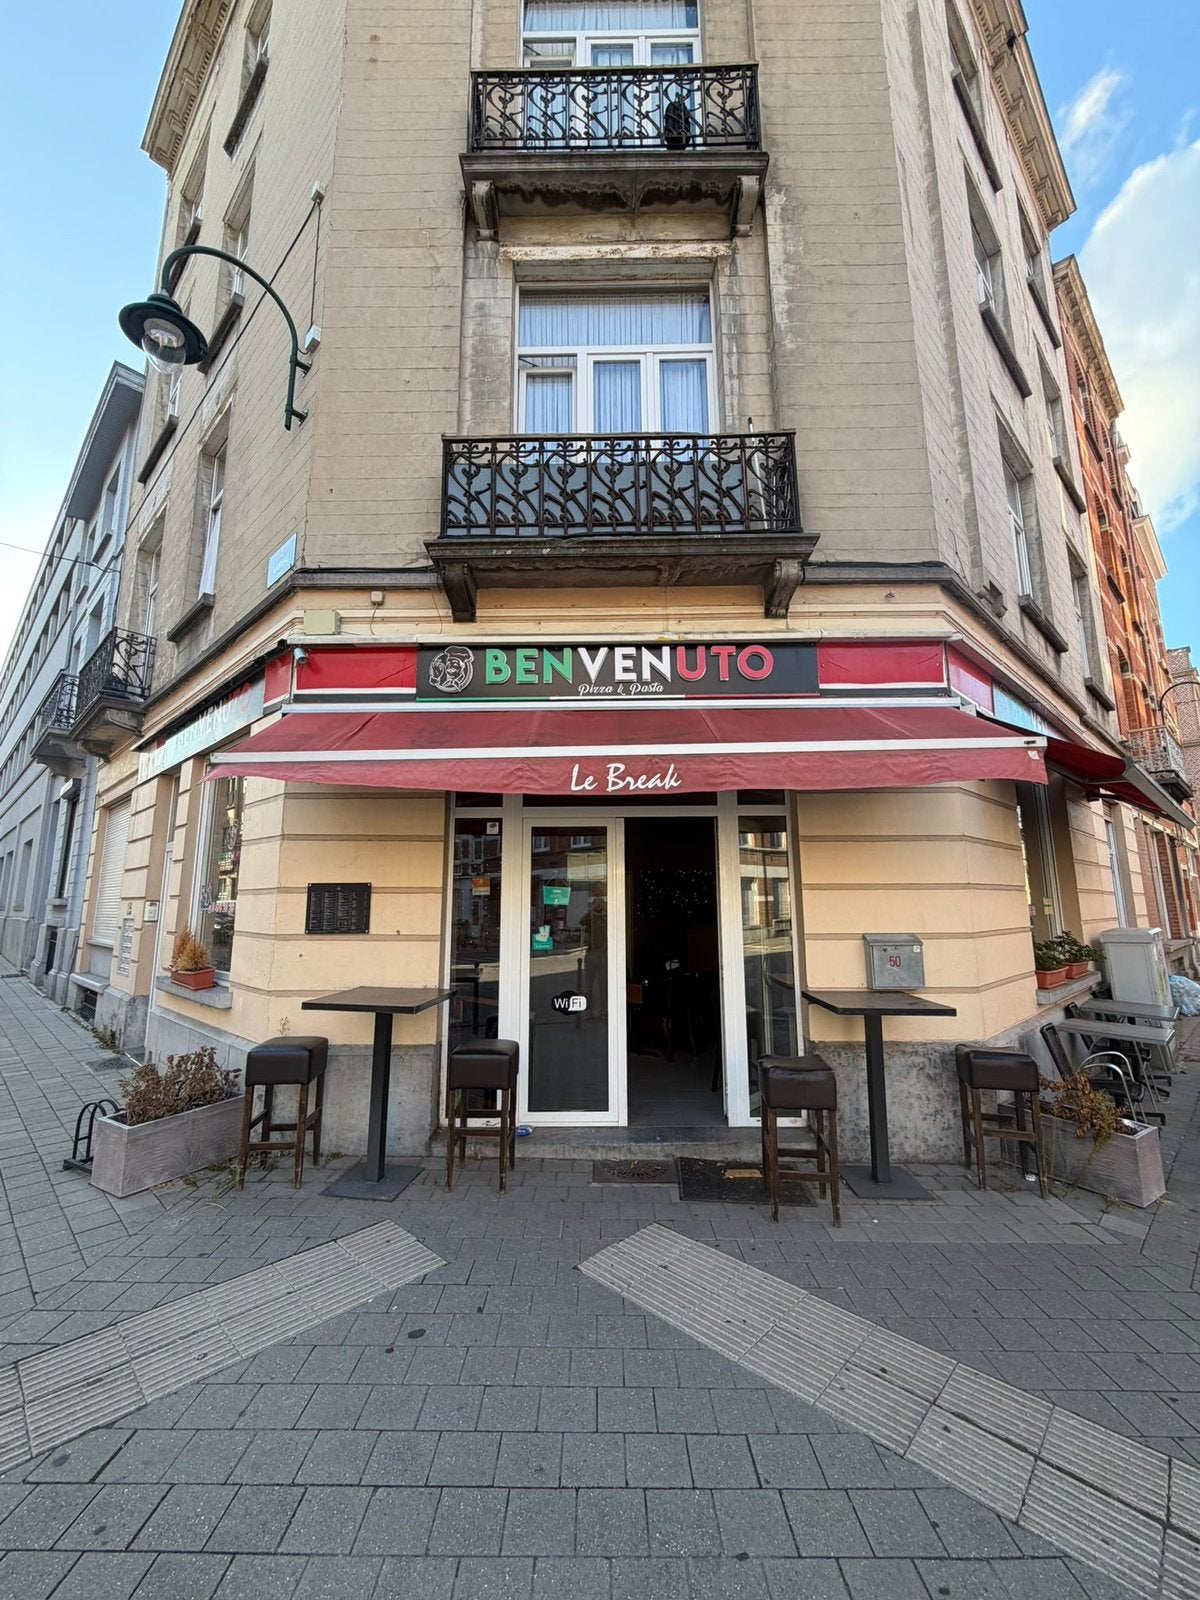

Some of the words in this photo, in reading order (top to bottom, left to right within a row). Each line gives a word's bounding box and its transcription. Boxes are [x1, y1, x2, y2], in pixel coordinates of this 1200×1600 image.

[485, 644, 774, 684] BENVENUTO
[578, 683, 614, 696] Pizza
[617, 684, 625, 694] &
[630, 682, 665, 695] Pasta
[570, 763, 598, 791] Le
[606, 763, 682, 791] Break
[889, 955, 902, 967] 50
[554, 997, 582, 1009] WiFi
